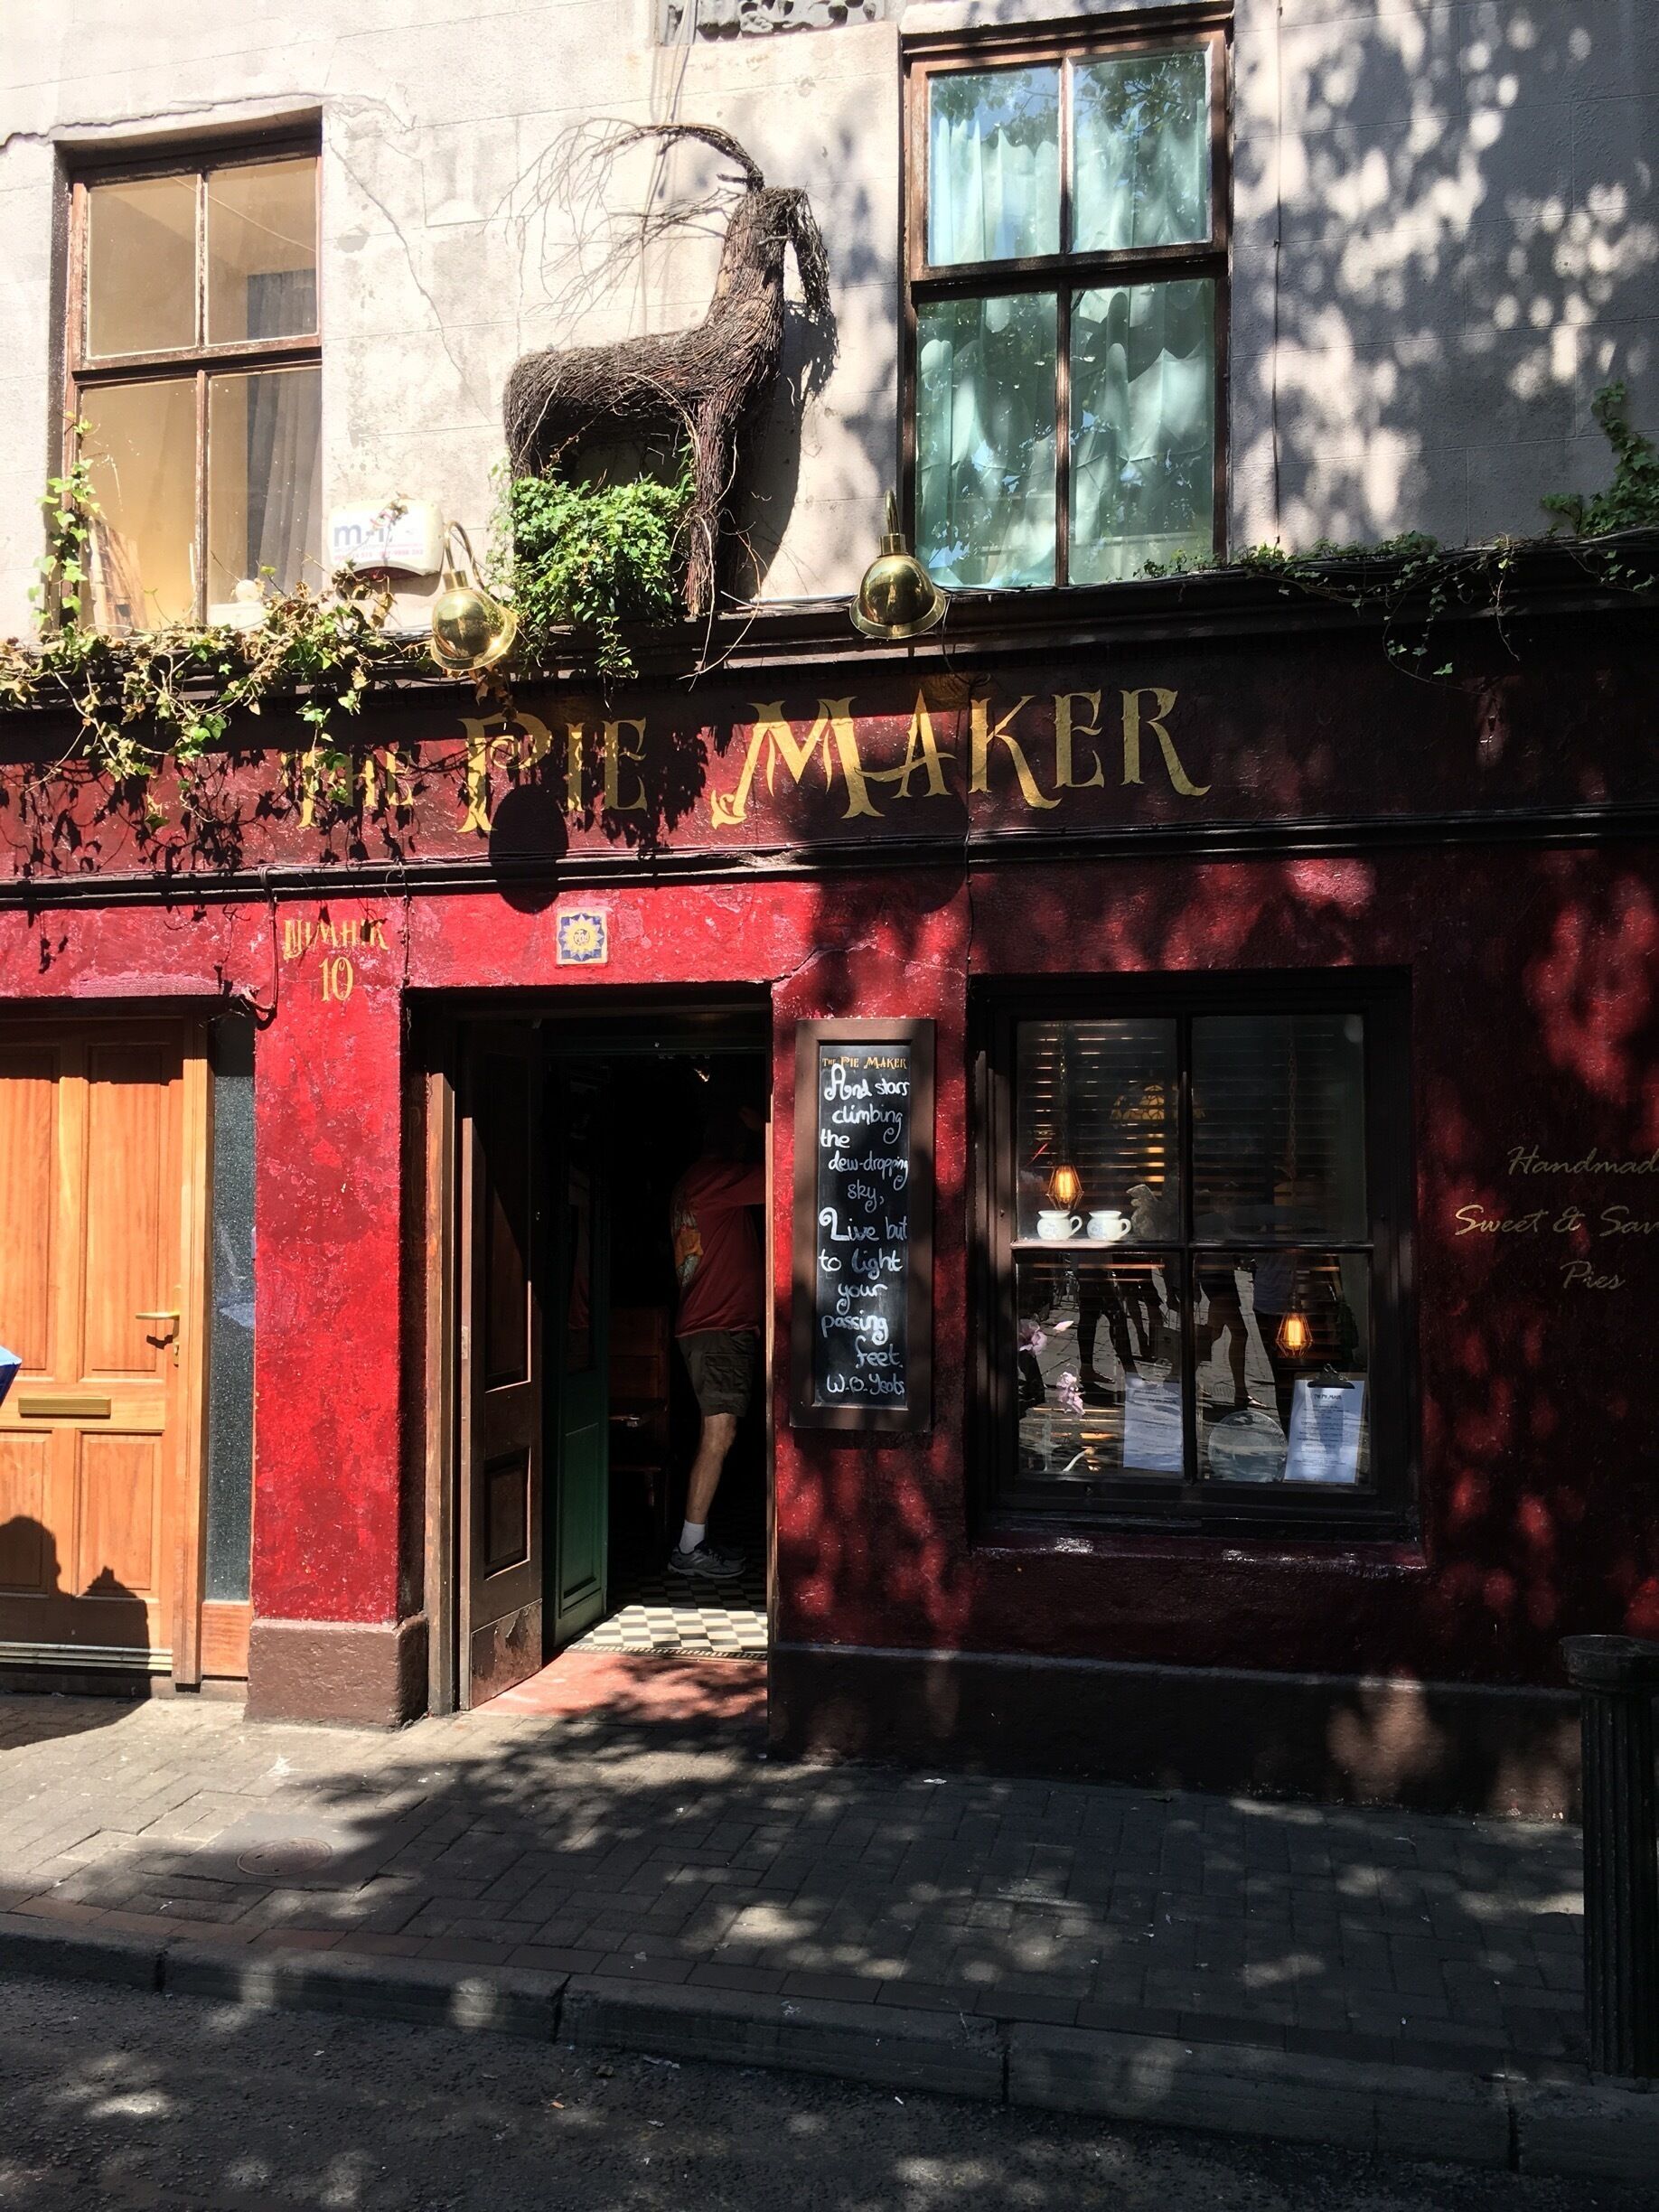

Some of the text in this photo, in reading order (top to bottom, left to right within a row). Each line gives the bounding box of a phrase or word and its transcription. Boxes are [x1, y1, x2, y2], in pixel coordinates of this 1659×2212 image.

[457, 712, 647, 833] PIE
[712, 688, 1213, 830] MAKER
[318, 956, 353, 1002] 10
[840, 1055, 859, 1068] PIE
[864, 1056, 907, 1070] MAKER
[824, 1063, 910, 1101] And stars
[820, 1129, 850, 1148] the
[831, 1103, 904, 1145] climbing
[828, 1150, 909, 1191] dew-dropping
[1507, 1144, 1659, 1176] Handmad
[847, 1179, 885, 1213] sky,
[819, 1206, 907, 1242] Live but
[1455, 1204, 1549, 1236] Sweet
[1553, 1206, 1586, 1233] &
[818, 1248, 903, 1280] to light
[1560, 1261, 1626, 1290] Pies
[836, 1282, 888, 1315] your
[820, 1310, 889, 1346] passing
